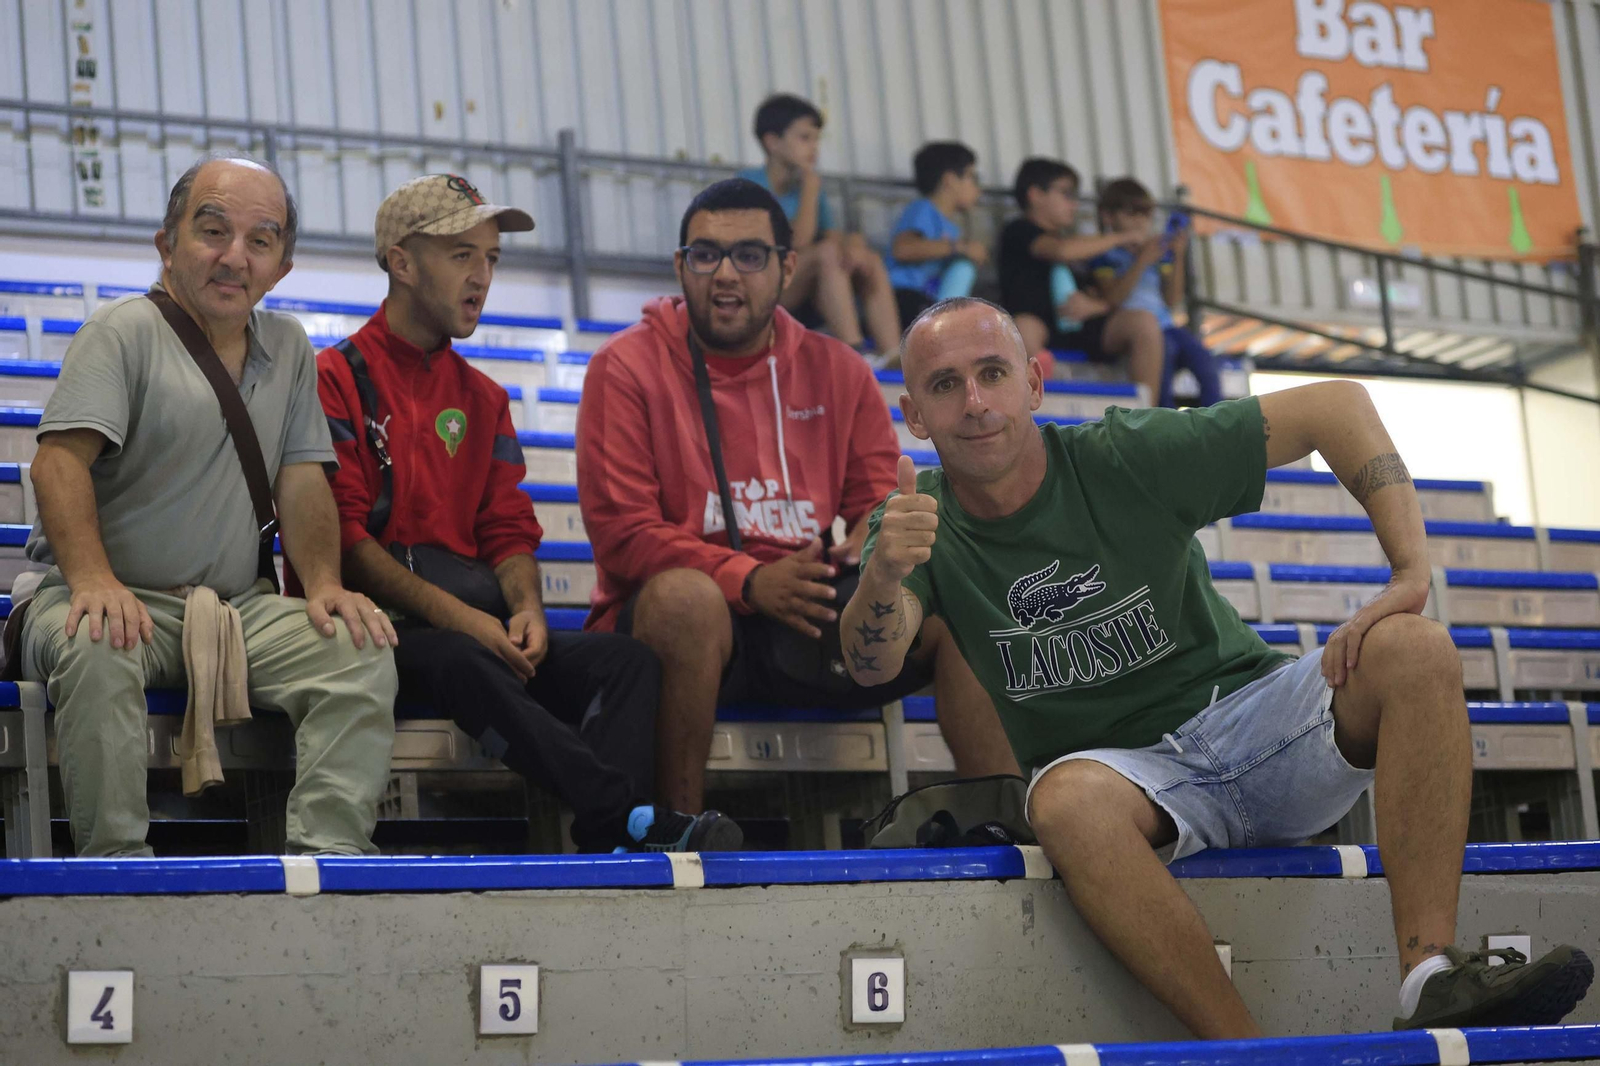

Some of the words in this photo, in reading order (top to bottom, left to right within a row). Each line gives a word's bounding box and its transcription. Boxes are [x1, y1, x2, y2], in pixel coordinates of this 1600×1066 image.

[1295, 0, 1435, 72] Bar
[1187, 57, 1561, 185] Cafetería
[703, 490, 821, 542] GMERS
[996, 598, 1169, 691] LACOSTE
[90, 986, 115, 1030] 4
[498, 978, 522, 1022] 5
[867, 971, 889, 1012] 6
